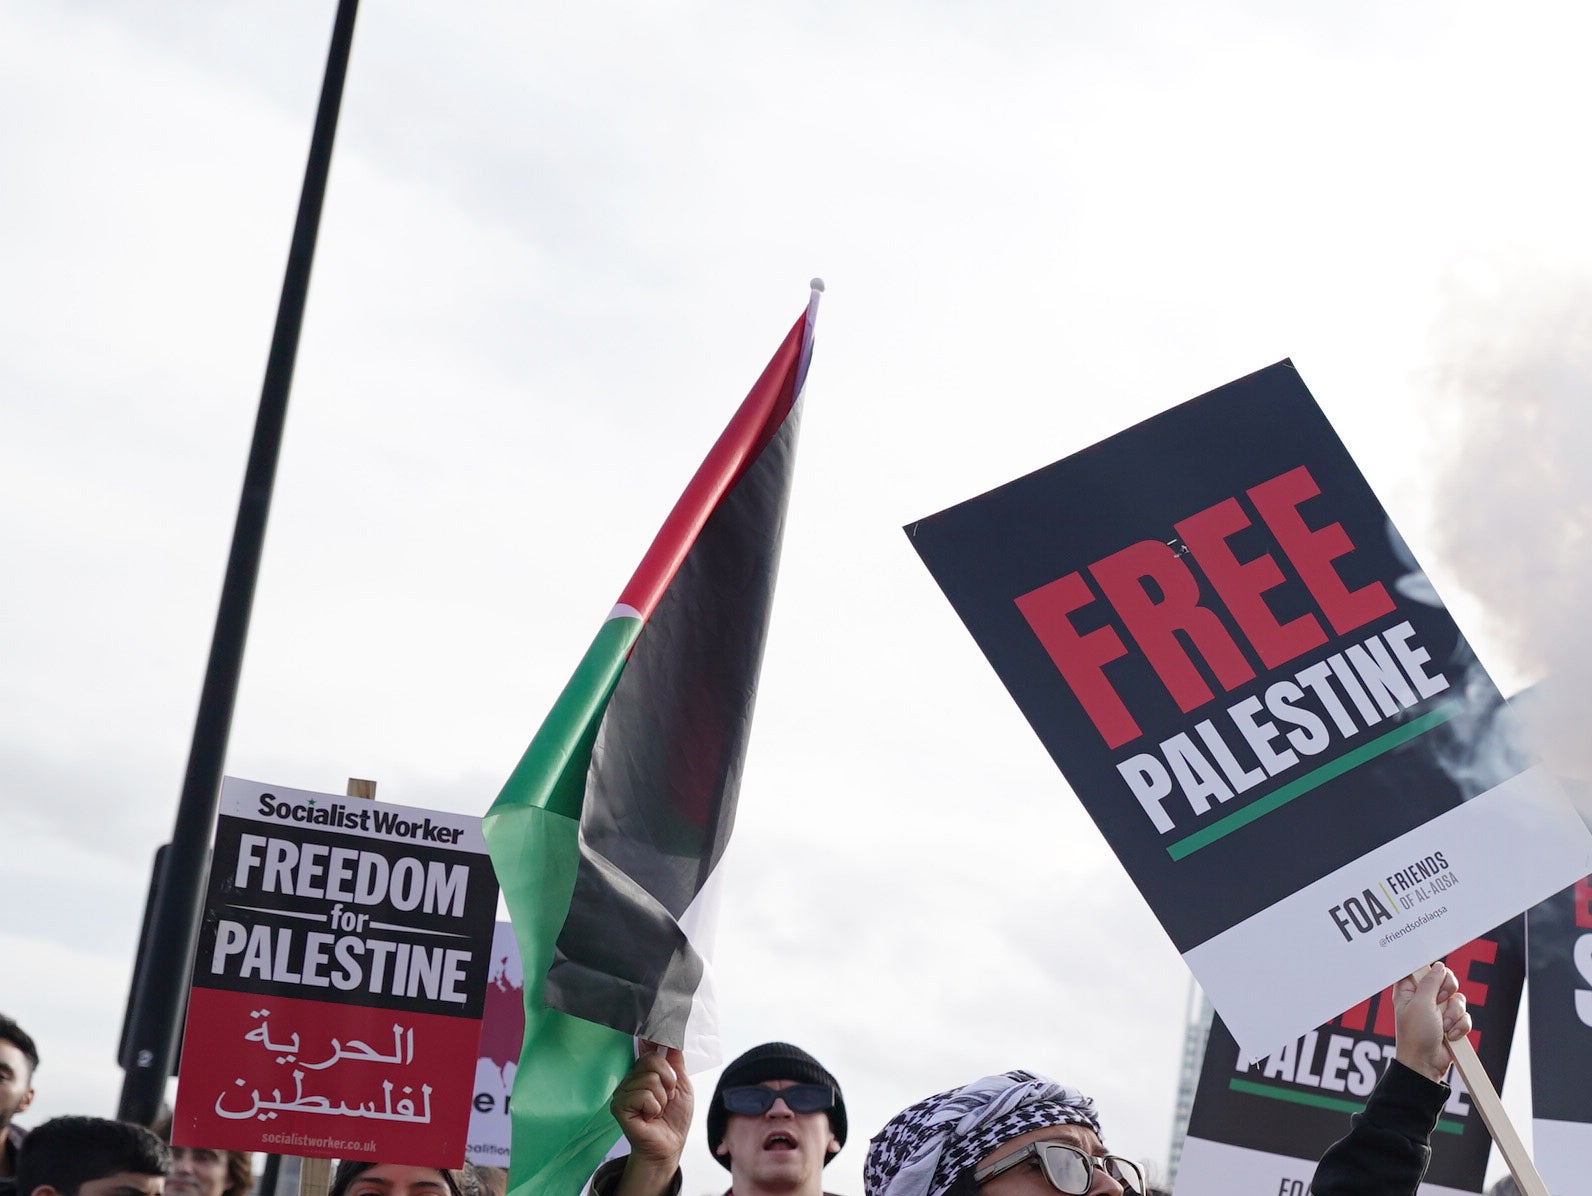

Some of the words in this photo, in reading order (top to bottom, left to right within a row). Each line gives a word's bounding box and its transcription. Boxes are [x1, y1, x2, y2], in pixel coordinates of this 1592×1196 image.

[1013, 465, 1397, 750] FREE
[1116, 620, 1450, 834] PALESTINE
[258, 793, 370, 832] Socialist
[373, 809, 464, 845] Worker
[234, 833, 470, 918] FREEDOM
[1386, 851, 1449, 895] FRIENDS
[1399, 892, 1416, 910] OF
[1415, 871, 1459, 903] AL-AQSA
[331, 903, 369, 933] for
[1328, 888, 1393, 942] FOA
[1379, 905, 1448, 947] @friendsofalaqsa
[211, 920, 472, 1004] PALESTINE
[244, 1008, 414, 1070] الحرية
[214, 1069, 433, 1123] لفلسطين
[262, 1132, 377, 1153] socialistworker.co.uk
